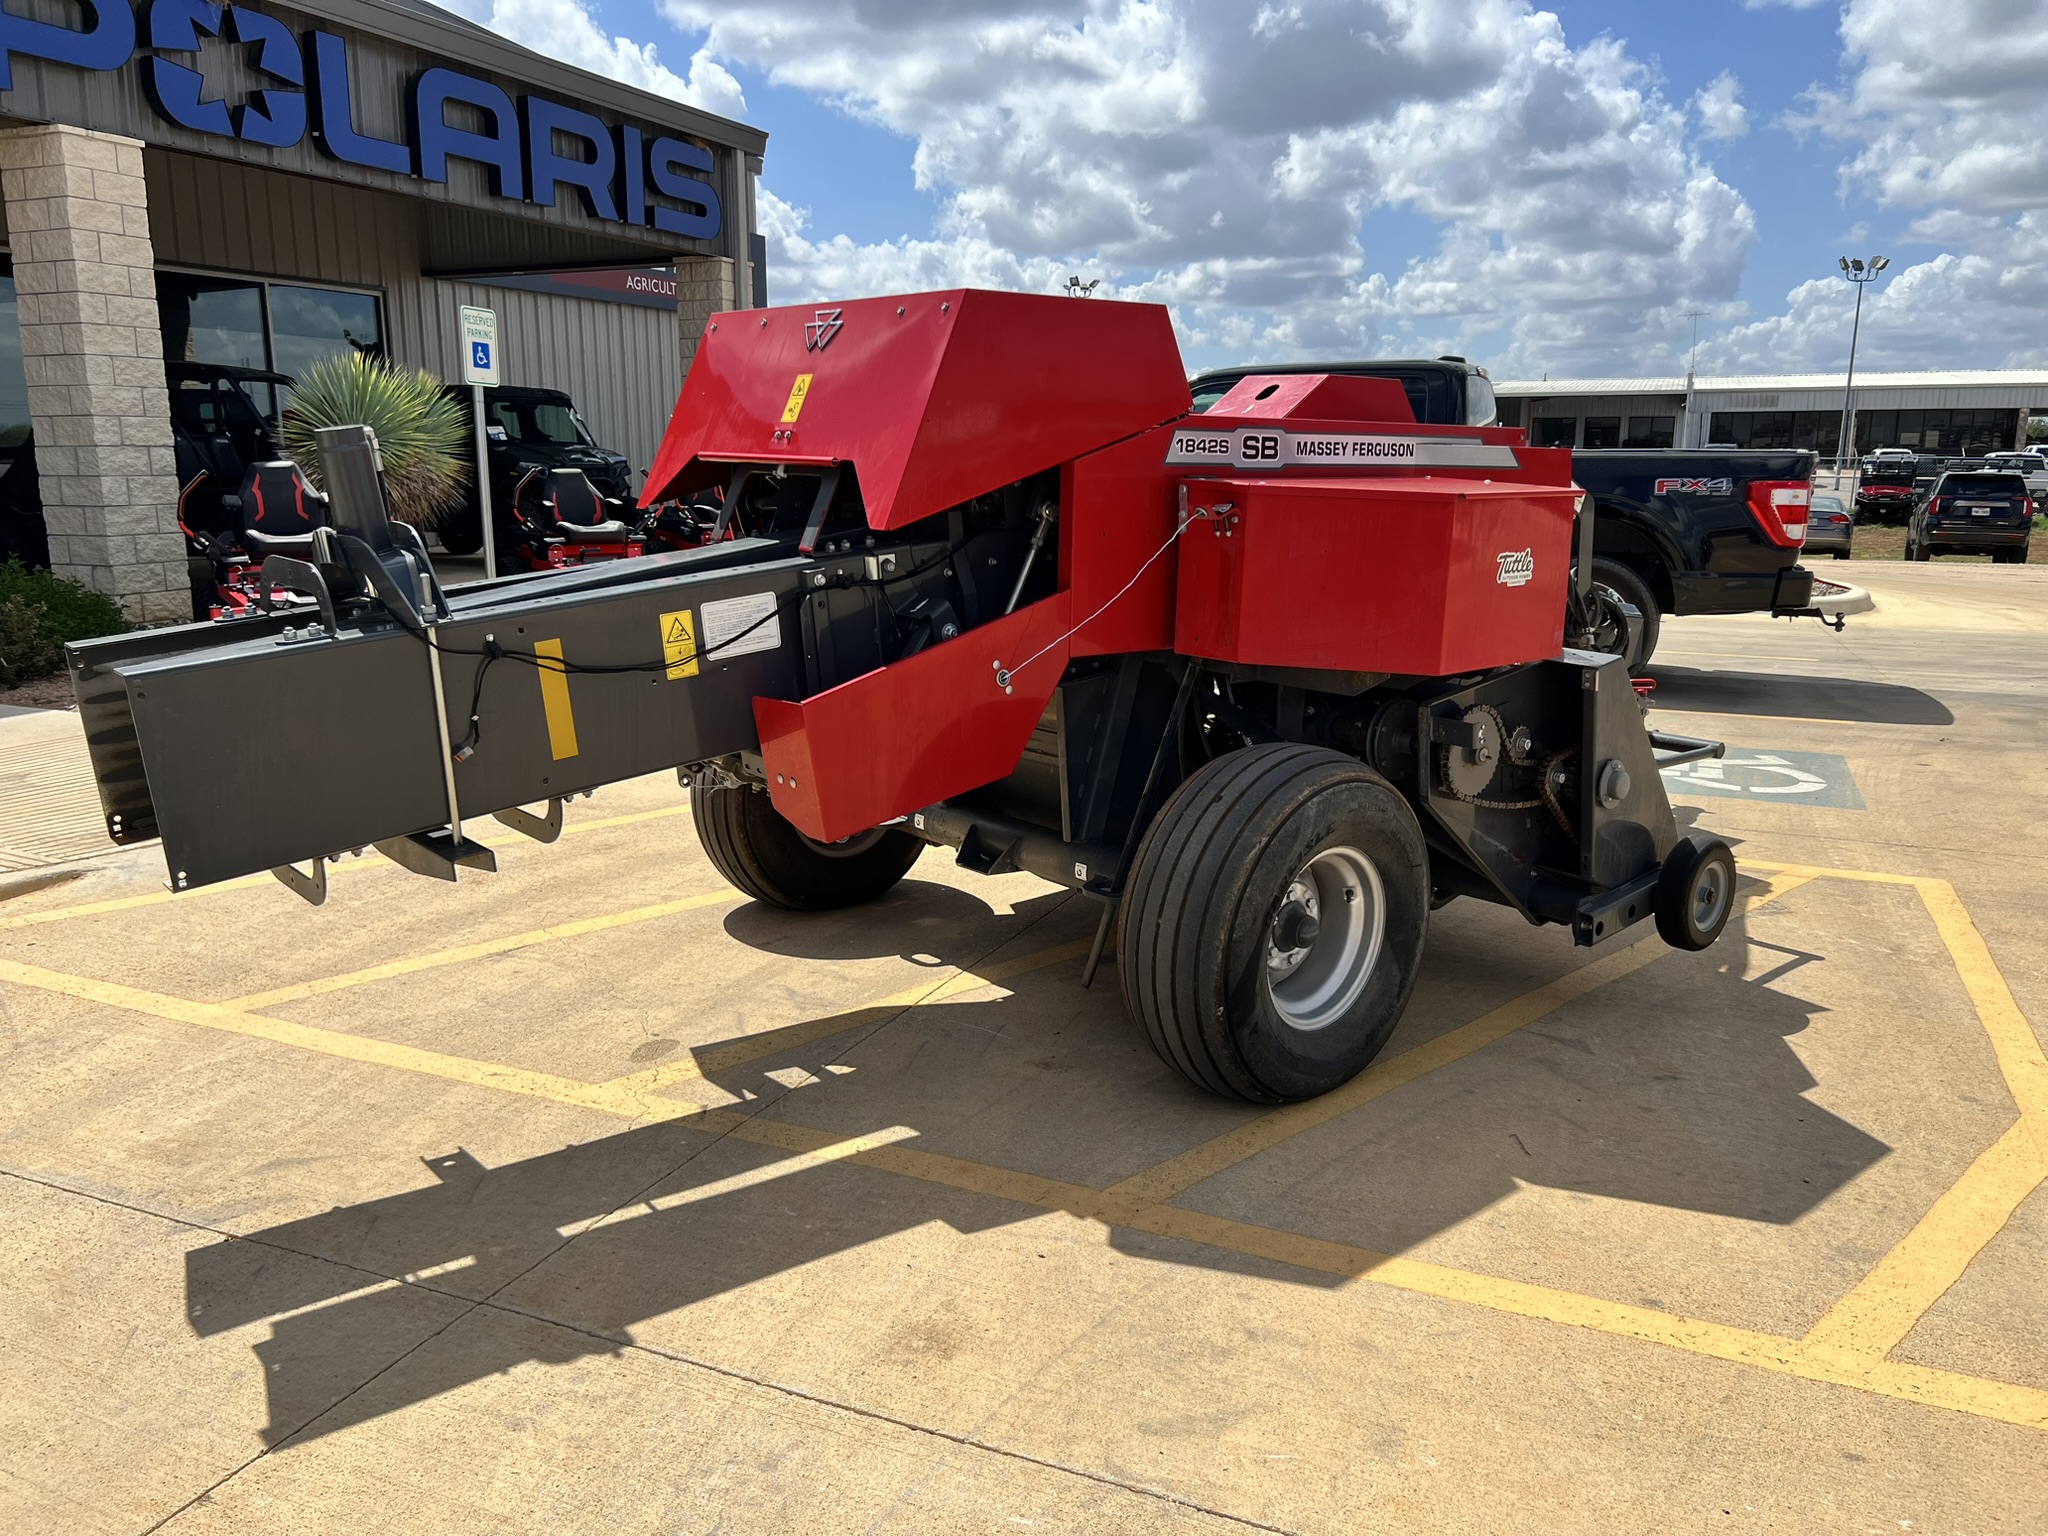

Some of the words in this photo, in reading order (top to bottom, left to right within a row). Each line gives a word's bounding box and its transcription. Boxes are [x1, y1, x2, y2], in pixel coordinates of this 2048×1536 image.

[0, 0, 721, 240] POLARIS
[464, 314, 493, 327] RESERVED
[467, 328, 493, 340] PARKING
[1175, 438, 1230, 454] 1842S
[1241, 436, 1279, 460] SB
[1296, 441, 1349, 456] MASSEY
[1352, 442, 1415, 457] FERGUSON
[1654, 478, 1733, 495] FX4
[1498, 550, 1532, 581] Tuttle
